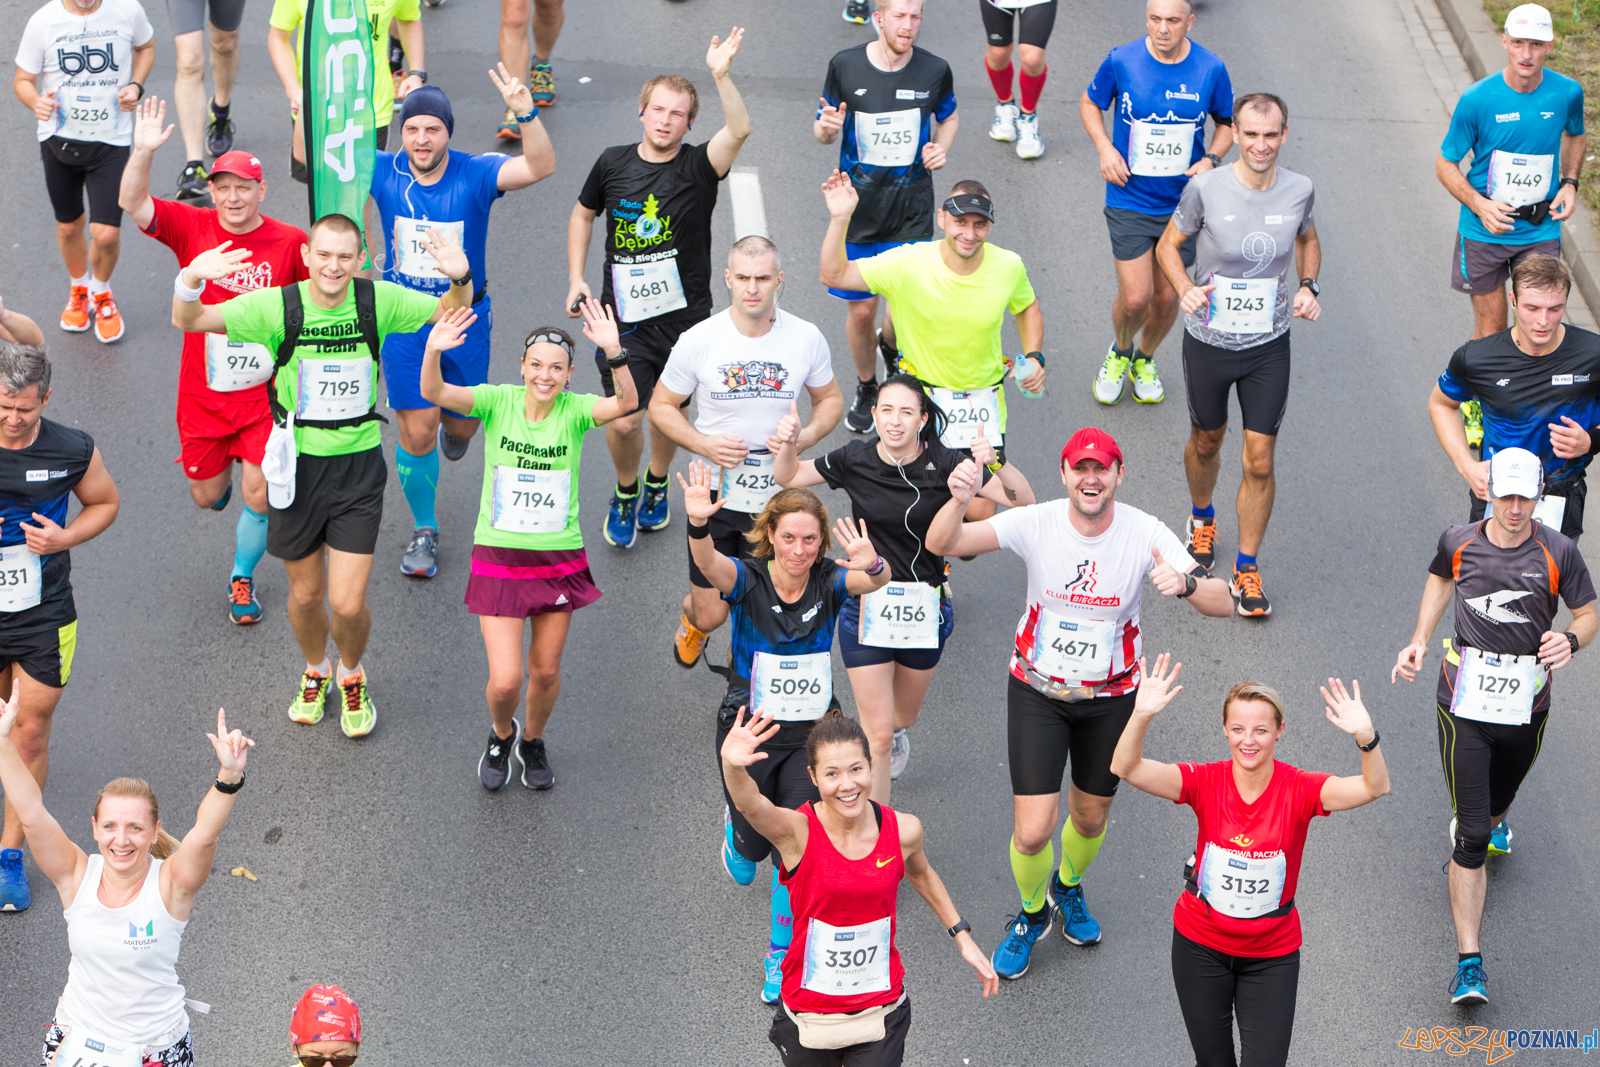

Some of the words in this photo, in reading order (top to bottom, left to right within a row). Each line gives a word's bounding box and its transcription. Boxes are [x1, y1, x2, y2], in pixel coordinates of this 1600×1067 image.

[57, 43, 119, 76] bbl
[71, 107, 109, 121] 3236
[1495, 112, 1520, 120] PHILIPS
[872, 130, 912, 146] 7435
[1145, 142, 1182, 156] 5416
[1505, 172, 1542, 187] 1449
[620, 199, 642, 209] Rada
[615, 230, 673, 251] Dębiec
[635, 248, 678, 263] Biegacza
[1241, 231, 1277, 278] 9
[630, 280, 669, 299] 6681
[1225, 297, 1264, 311] 1243
[227, 356, 260, 370] 974
[319, 380, 360, 396] 7195
[947, 408, 989, 423] 6240
[500, 435, 568, 458] Pacemaker
[516, 456, 551, 470] Team
[512, 490, 555, 508] 7194
[1046, 589, 1068, 600] KLUB
[1072, 595, 1118, 606] BIEGACZA
[880, 604, 926, 622] 4156
[1051, 637, 1098, 659] 4671
[769, 677, 822, 695] 5096
[1478, 674, 1521, 694] 1279
[1253, 849, 1283, 859] PACZKA
[1221, 874, 1270, 895] 3132
[124, 937, 158, 946] MATUSZAK
[825, 945, 878, 968] 3307
